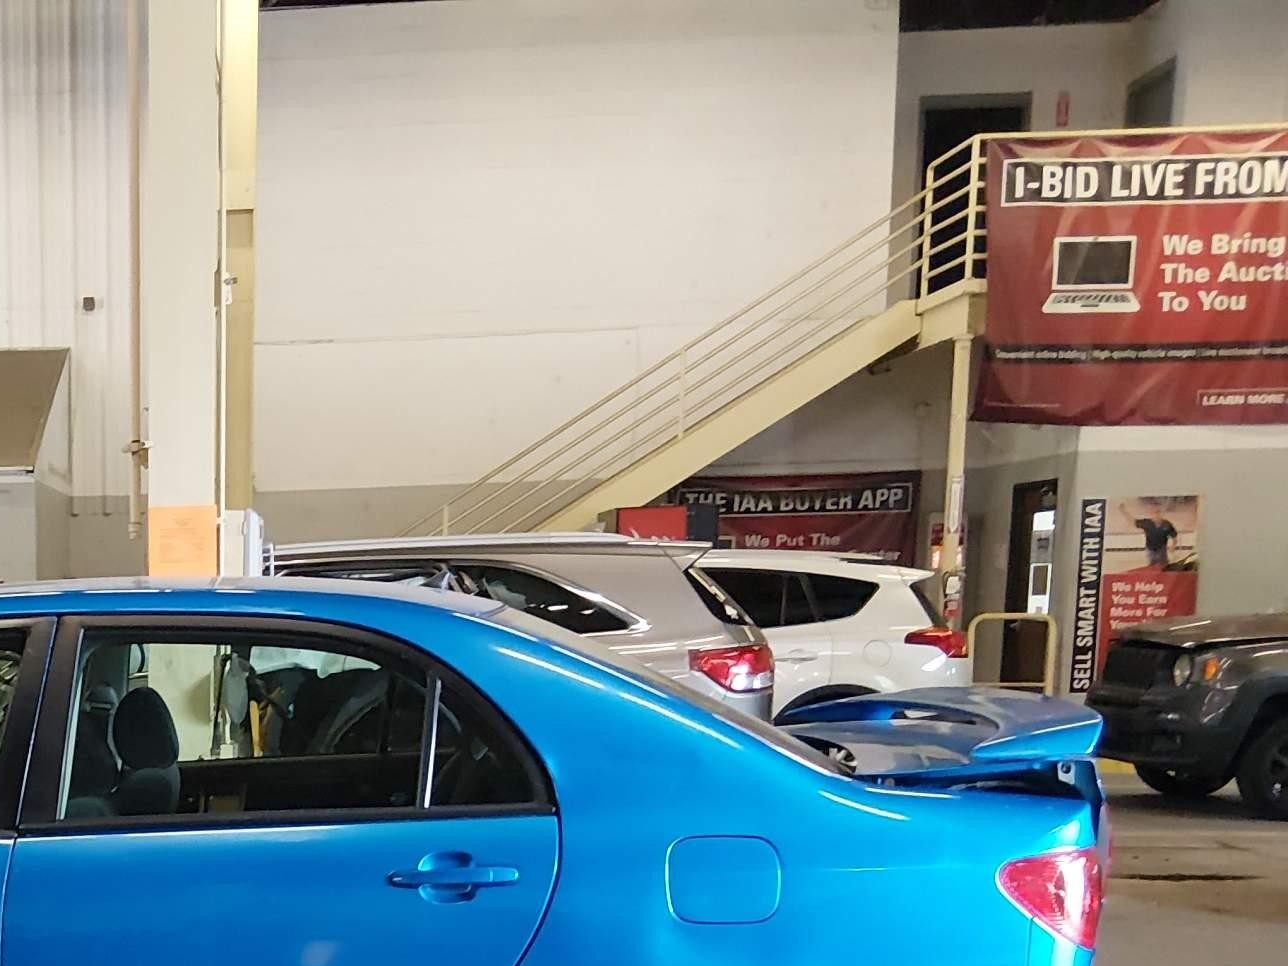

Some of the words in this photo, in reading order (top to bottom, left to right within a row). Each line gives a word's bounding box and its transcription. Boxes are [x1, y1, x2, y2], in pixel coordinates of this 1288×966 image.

[1014, 165, 1100, 199] I-BID
[1110, 162, 1189, 198] LIVE
[1161, 234, 1204, 256] We
[1211, 232, 1286, 259] Bring
[1159, 262, 1210, 284] The
[1157, 291, 1190, 312] To
[1198, 290, 1247, 312] You
[1201, 395, 1245, 407] LEARN
[1247, 393, 1286, 405] MORE
[733, 493, 773, 513] IAA
[858, 488, 904, 509] APP
[1083, 503, 1103, 532] IAA
[745, 534, 769, 548] We
[776, 534, 805, 547] Put
[809, 533, 841, 546] The
[1080, 537, 1101, 584] WITH
[1111, 594, 1136, 605] You
[1135, 581, 1164, 593] Help
[1077, 588, 1097, 646] SMART
[1073, 646, 1090, 690] SELL
